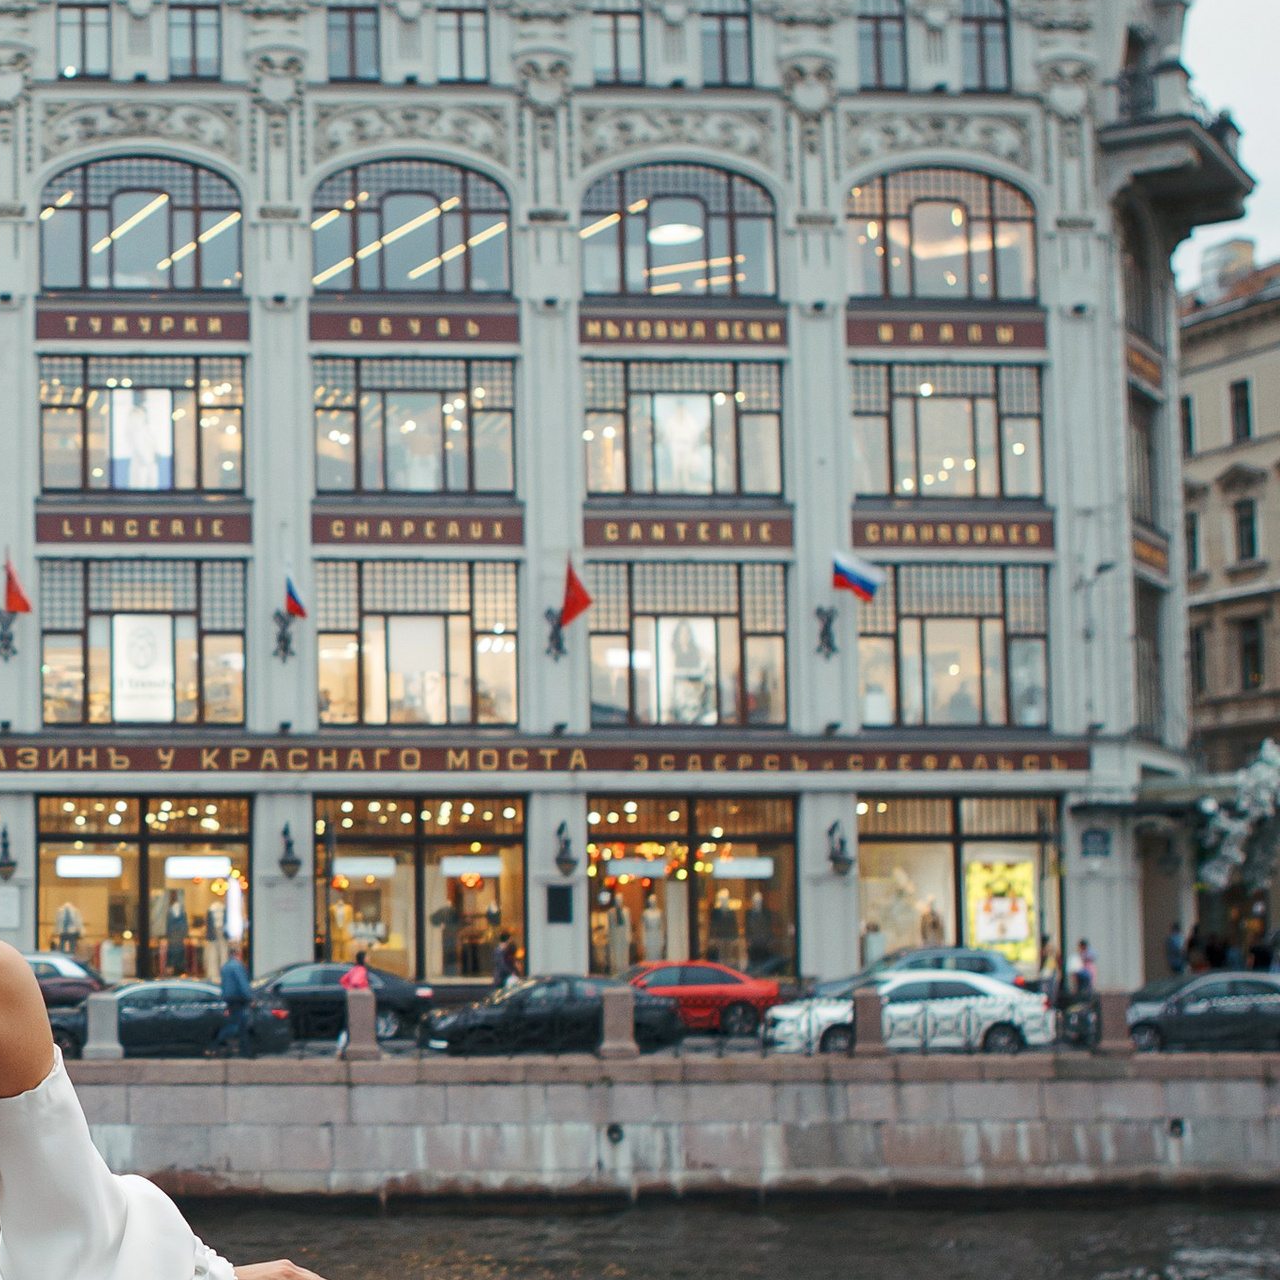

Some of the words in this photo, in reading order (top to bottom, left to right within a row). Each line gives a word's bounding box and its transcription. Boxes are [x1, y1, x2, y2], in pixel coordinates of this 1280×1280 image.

[65, 316, 222, 333] ТУЖУРКИ
[349, 317, 480, 337] ОБУВЬ
[331, 520, 502, 538] CHAPEAUX
[201, 748, 421, 770] КРАСНАГО
[447, 748, 587, 770] МОСТА
